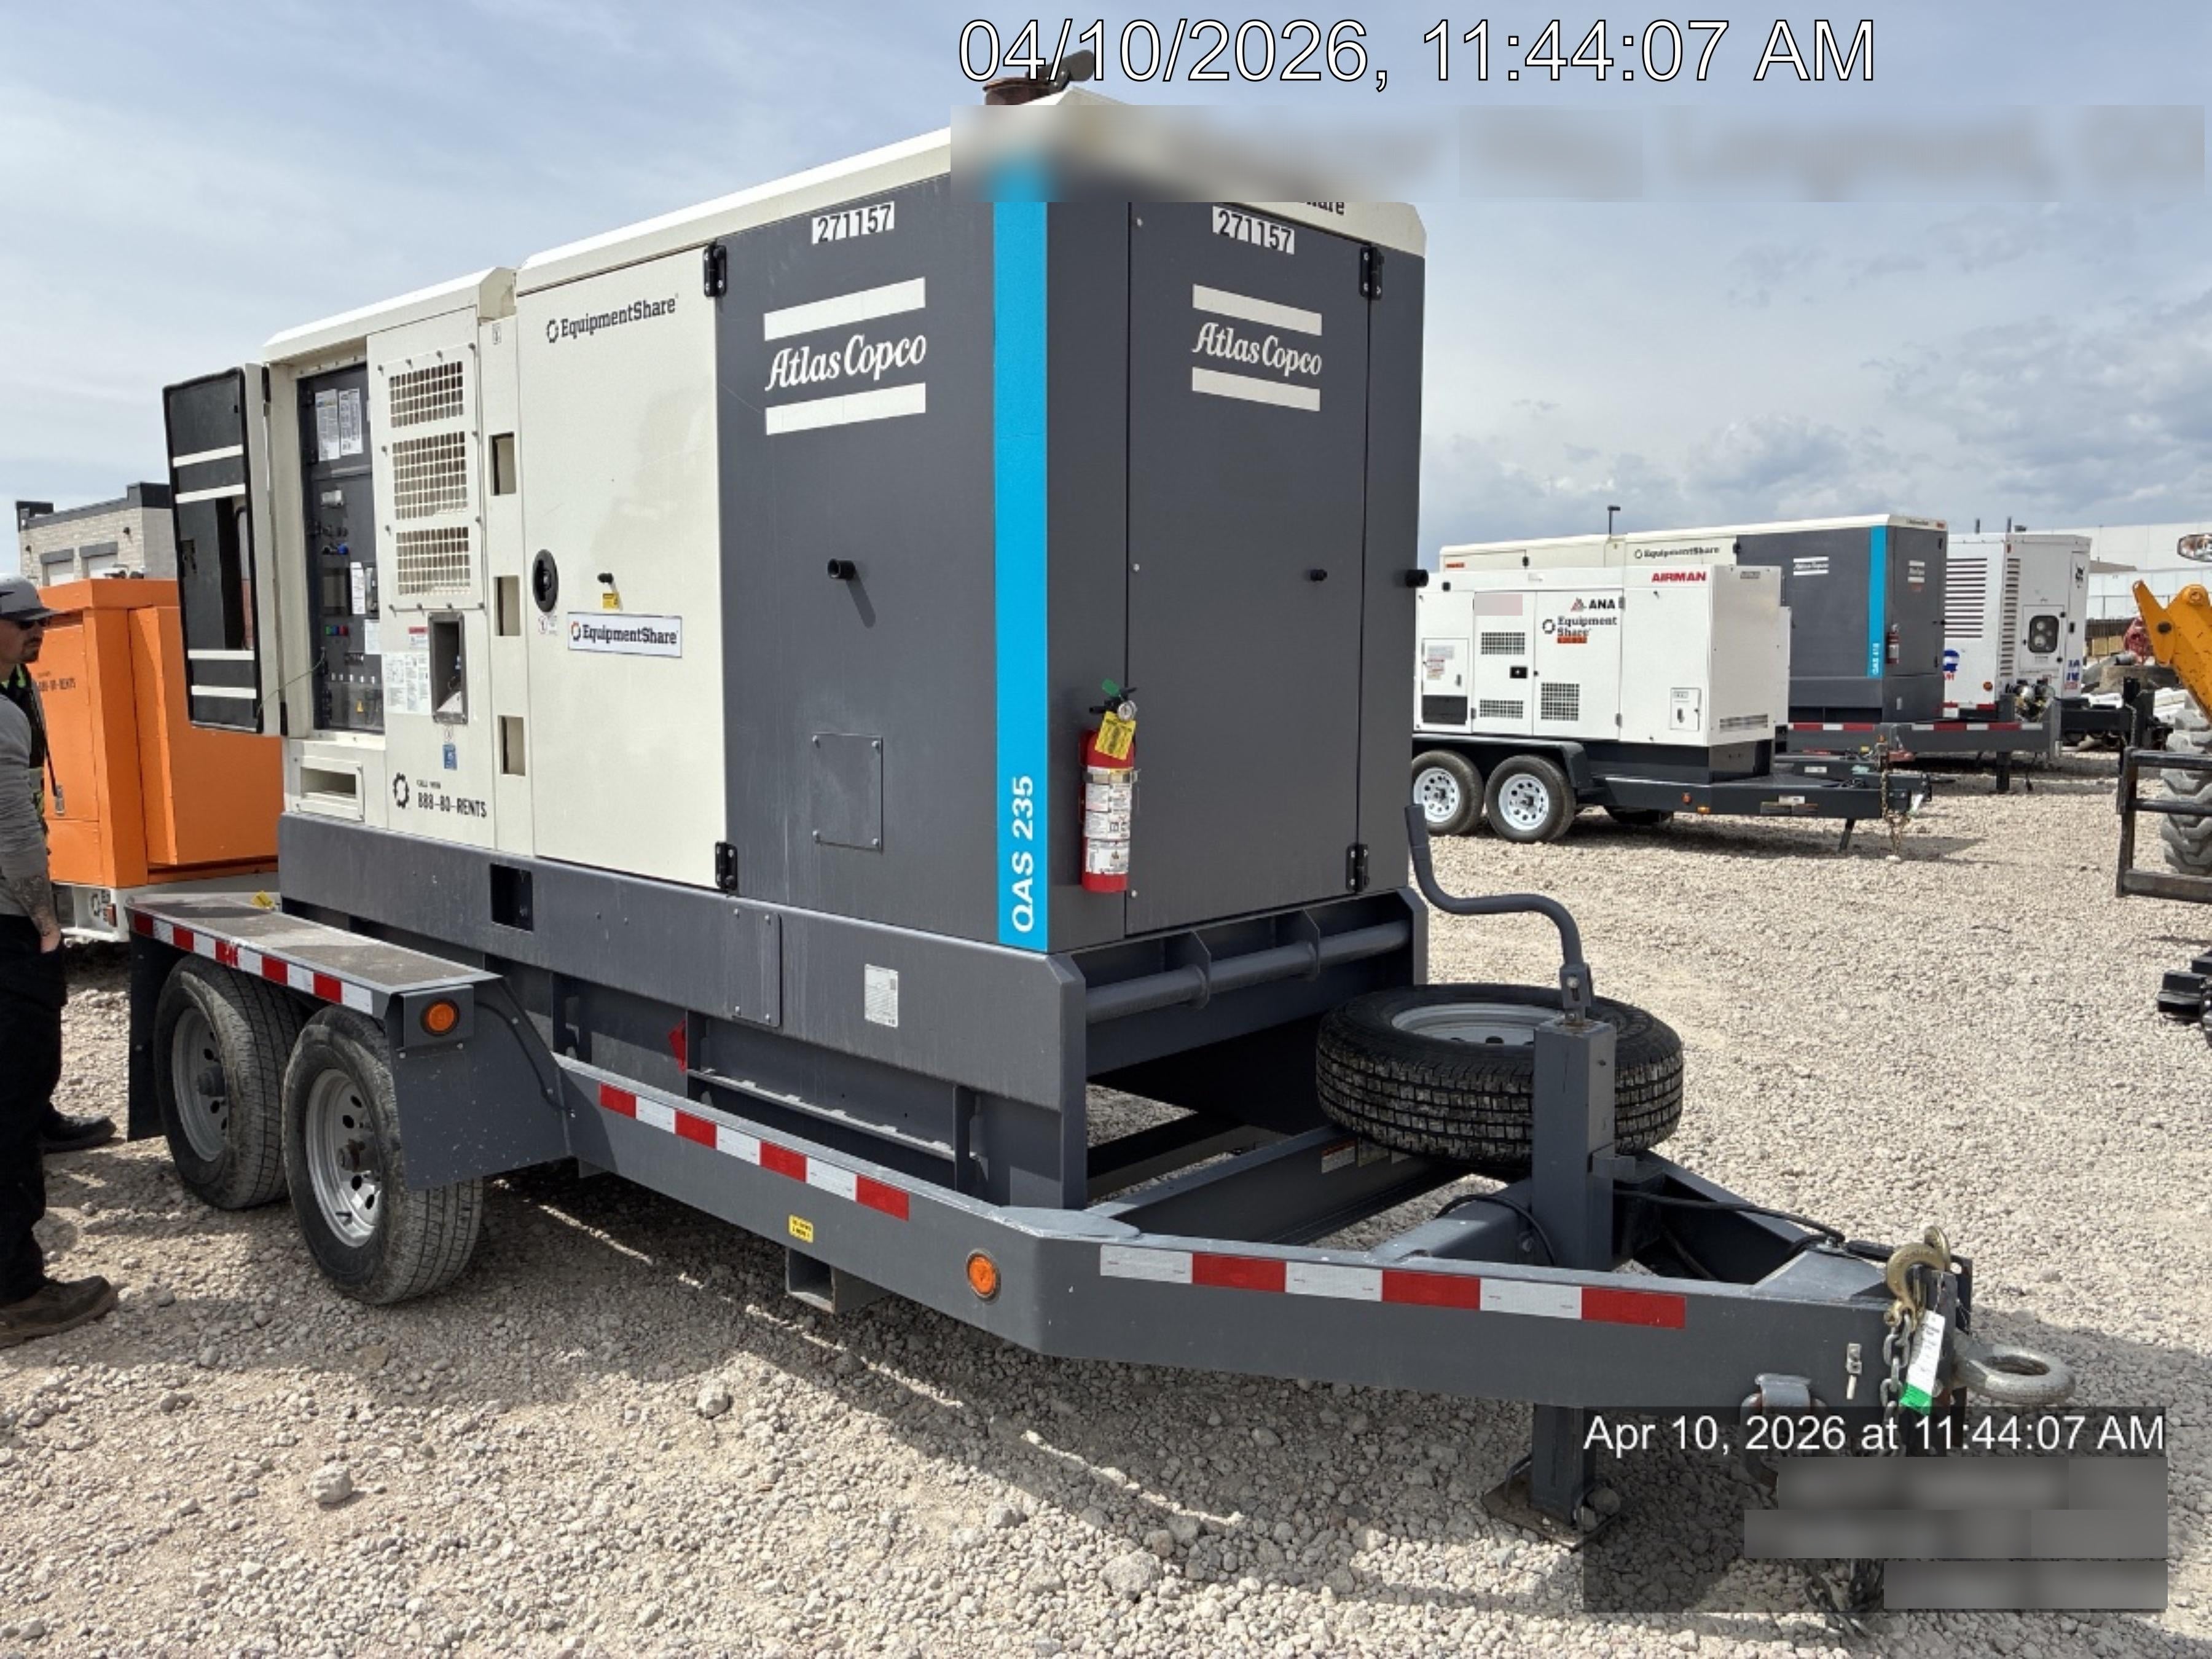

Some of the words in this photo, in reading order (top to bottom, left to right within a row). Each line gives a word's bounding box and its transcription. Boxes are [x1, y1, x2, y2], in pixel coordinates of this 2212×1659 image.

[817, 204, 892, 243] 271157
[1217, 210, 1292, 251] 271157
[560, 297, 676, 339] EquipmentShare
[764, 345, 842, 391] Atlas
[844, 333, 927, 380] Copco
[1192, 321, 1260, 364] Atlas
[1262, 335, 1322, 377] Copco
[1651, 571, 1706, 582] AIRMAN
[1558, 615, 1618, 627] Equipment
[1589, 598, 1615, 609] ANA
[582, 624, 677, 644] EquipmentShare
[1012, 775, 1033, 840] 235
[1012, 850, 1033, 933] QAS
